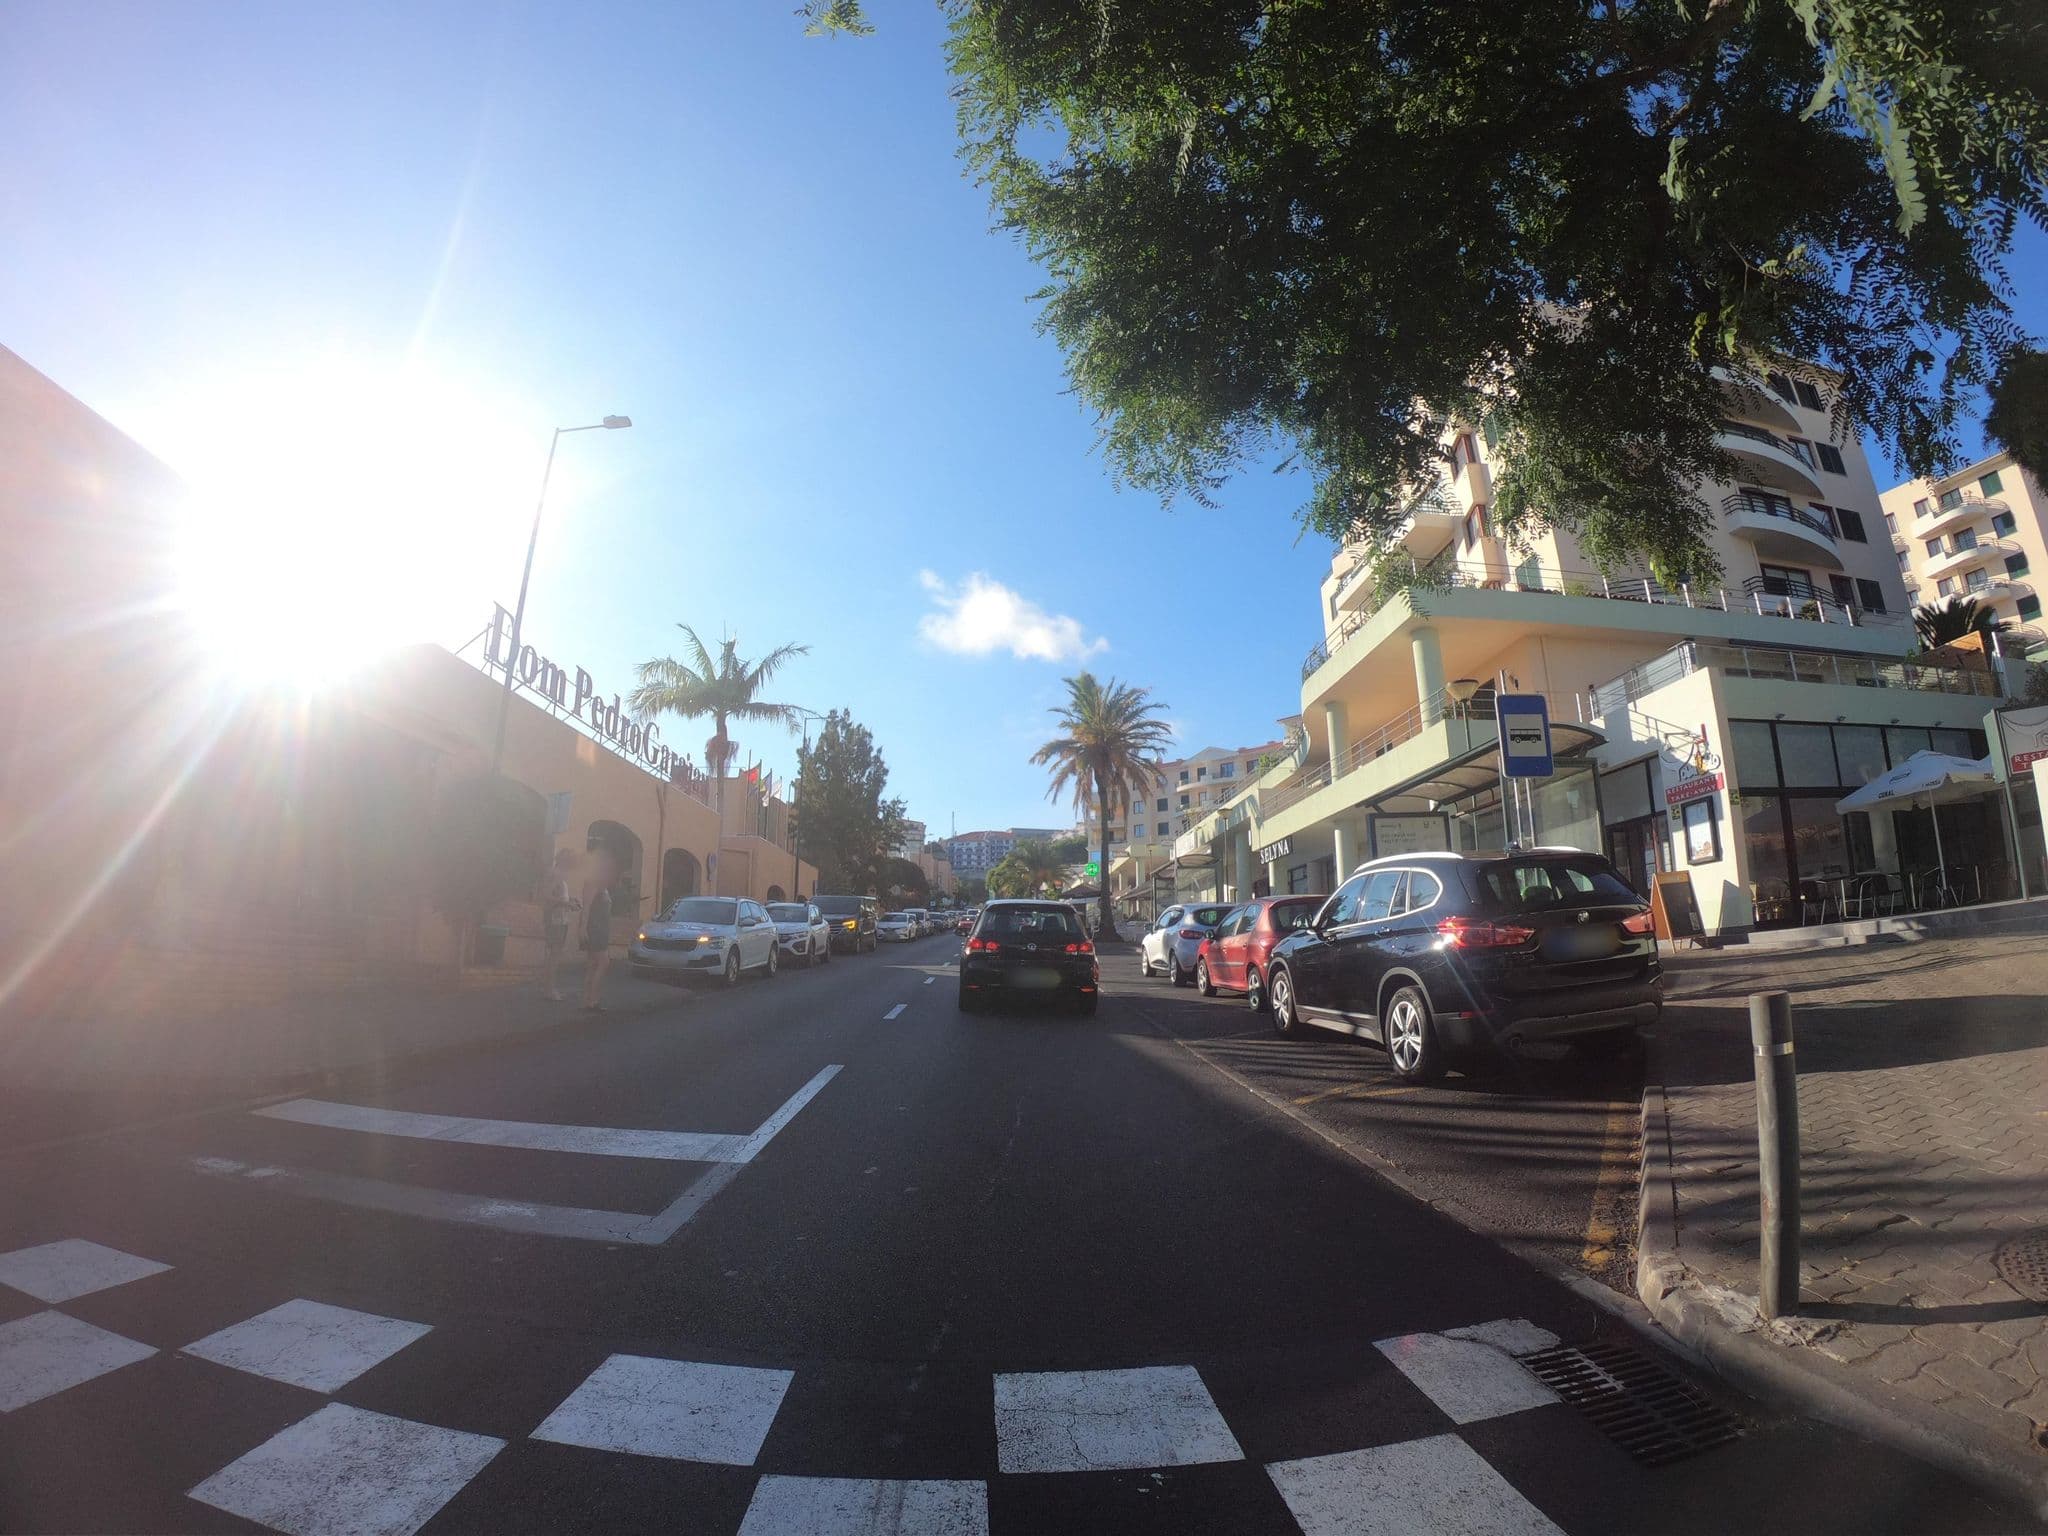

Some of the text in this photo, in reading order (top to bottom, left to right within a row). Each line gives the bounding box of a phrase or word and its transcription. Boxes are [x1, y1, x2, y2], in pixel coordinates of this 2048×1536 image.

[488, 601, 567, 707] Dom
[571, 664, 641, 756] Pedro
[1260, 838, 1290, 865] SELYNA
